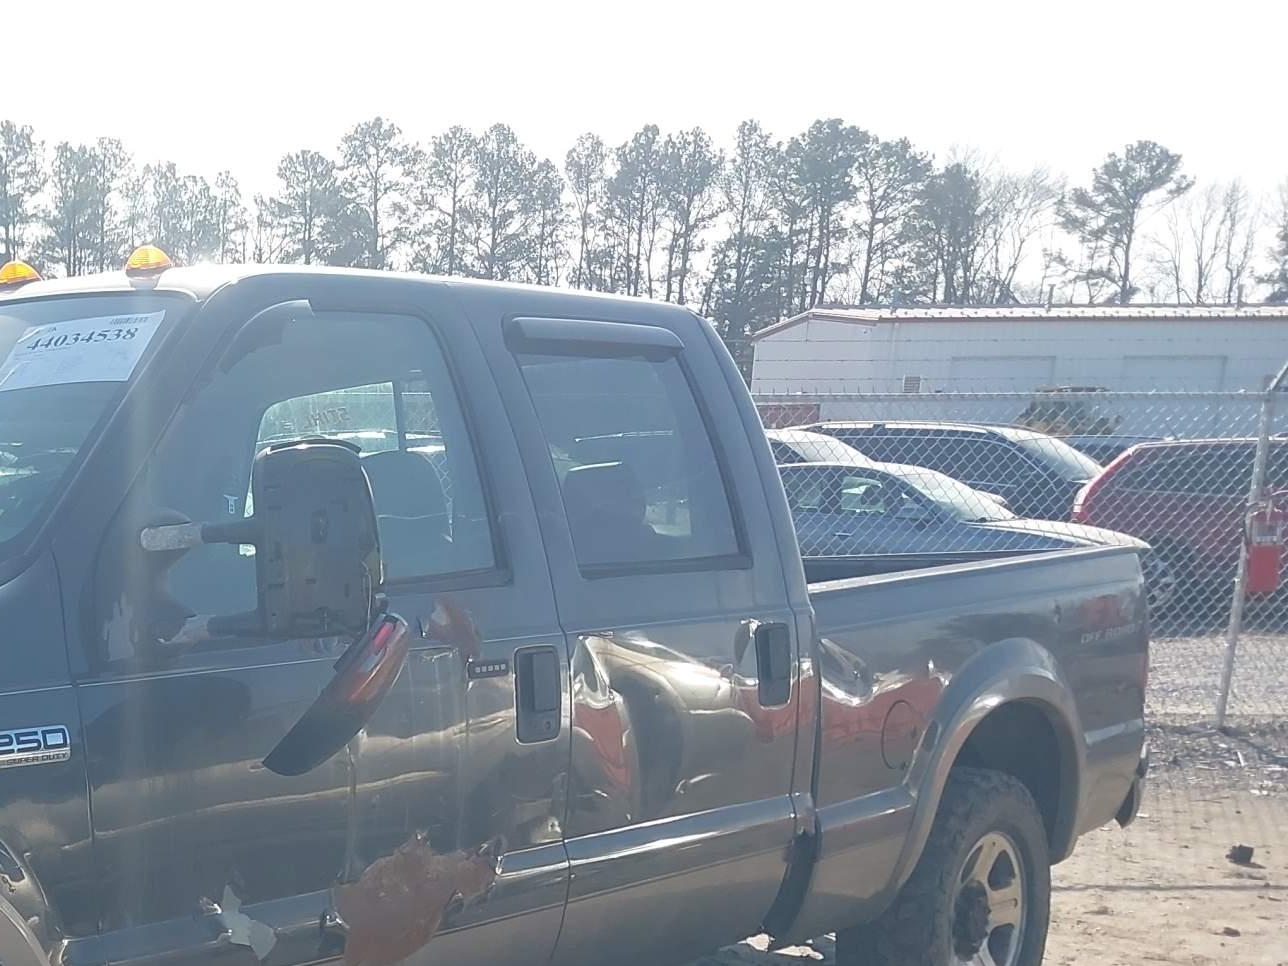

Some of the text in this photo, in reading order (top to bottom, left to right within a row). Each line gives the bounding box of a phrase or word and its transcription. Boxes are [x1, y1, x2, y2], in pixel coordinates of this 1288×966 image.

[27, 327, 139, 351] 44034538
[6, 755, 39, 766] SUPER
[41, 751, 69, 761] DUTY
